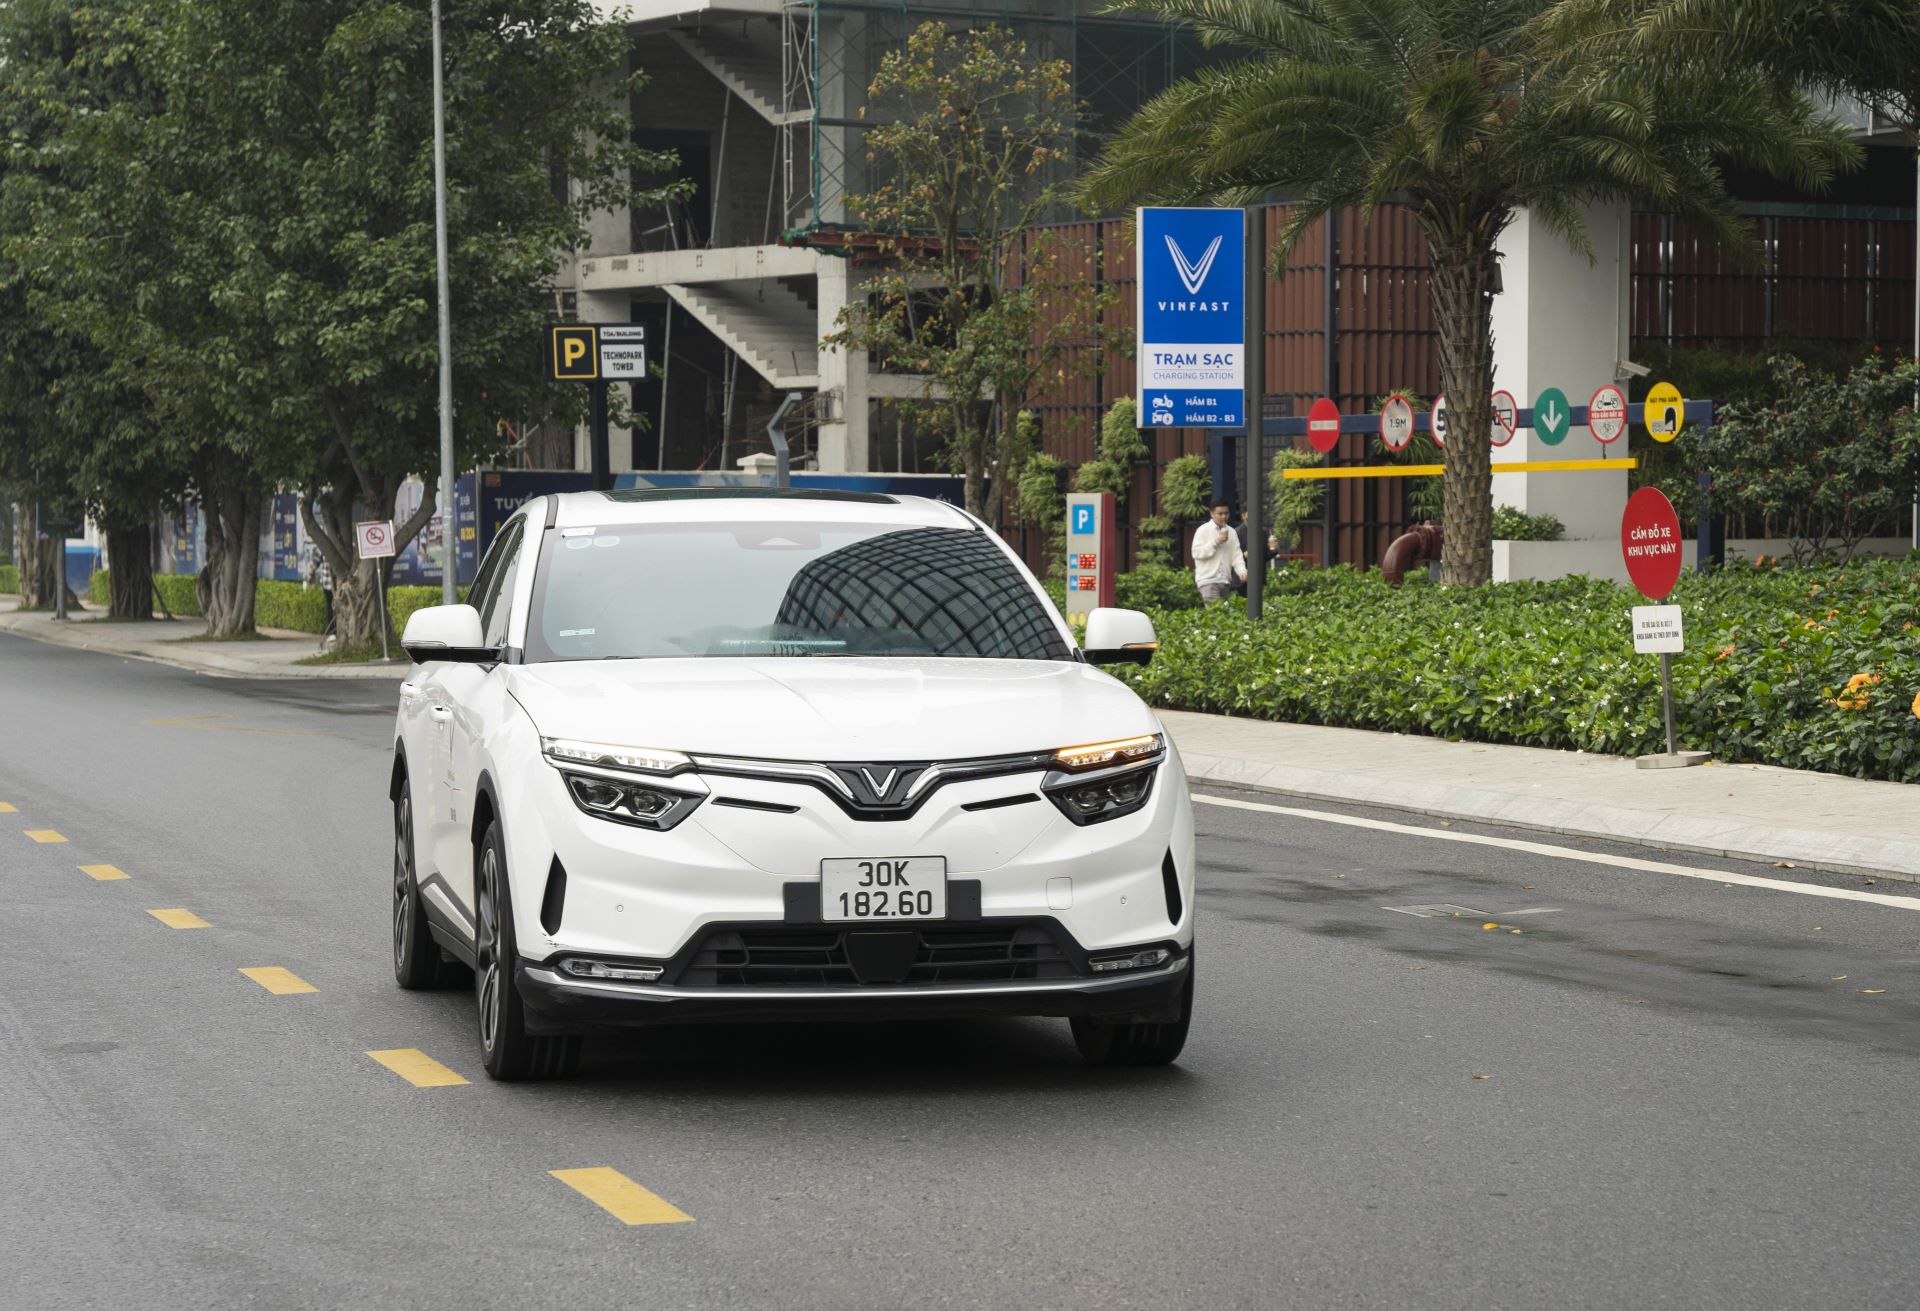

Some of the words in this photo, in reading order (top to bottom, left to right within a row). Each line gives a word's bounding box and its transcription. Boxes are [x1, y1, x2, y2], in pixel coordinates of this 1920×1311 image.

[1159, 302, 1229, 311] VINFAST
[564, 337, 586, 368] P
[603, 351, 643, 360] TECHNOPARK
[612, 362, 634, 371] TOWER
[1153, 353, 1197, 368] TRẠM
[1203, 353, 1233, 368] SẠC
[1153, 372, 1198, 380] CHARGING
[1199, 372, 1234, 380] STATION
[1224, 414, 1235, 422] B3
[1390, 418, 1406, 428] 1.9M
[1078, 509, 1088, 530] P
[1631, 526, 1647, 540] CẤM
[1648, 523, 1659, 538] ĐỖ
[1661, 527, 1671, 538] XE
[1627, 546, 1643, 557] KHU
[1644, 544, 1660, 557] VỰC
[1660, 541, 1677, 554] NÀY
[857, 860, 910, 887] 30K
[839, 890, 933, 917] 182.60
